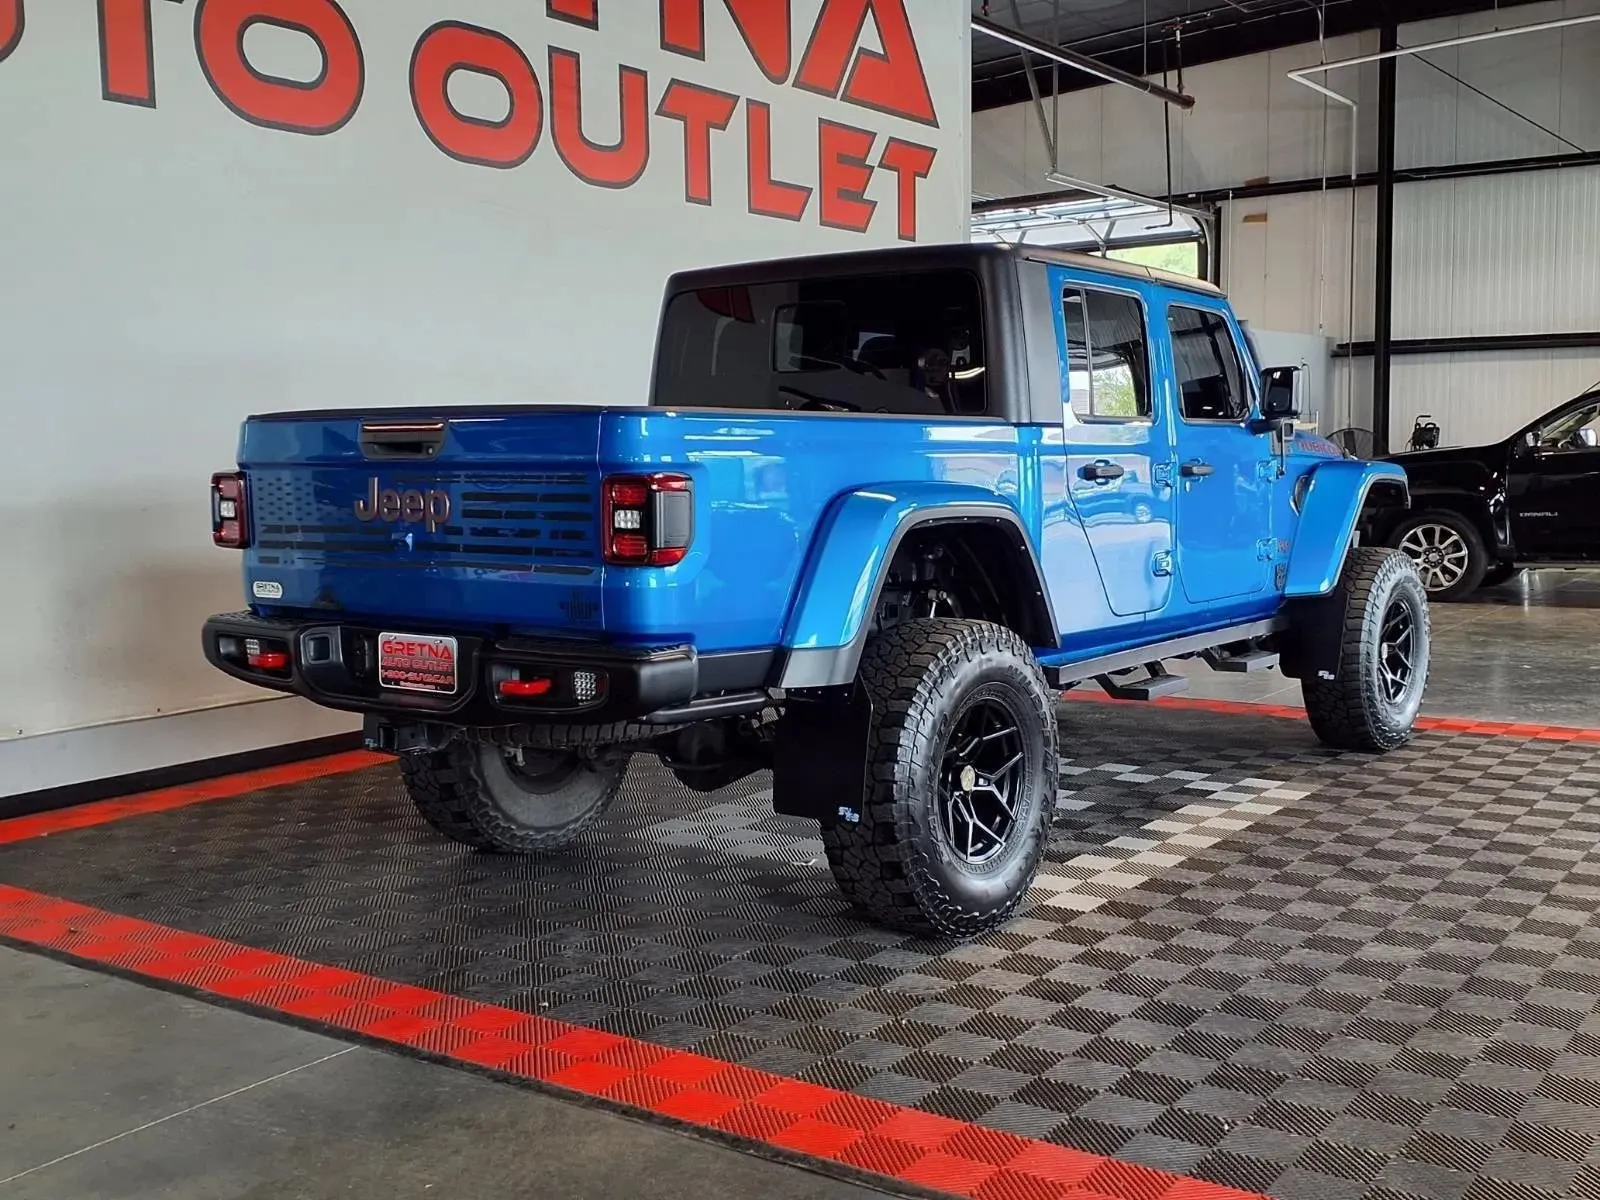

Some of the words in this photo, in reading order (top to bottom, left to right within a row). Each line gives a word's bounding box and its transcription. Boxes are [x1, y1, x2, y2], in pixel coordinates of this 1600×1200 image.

[0, 0, 365, 136] TO
[409, 20, 938, 242] OUTLET
[353, 476, 450, 534] Jeep
[382, 641, 452, 660] GRETNA
[382, 657, 410, 667] AUTO
